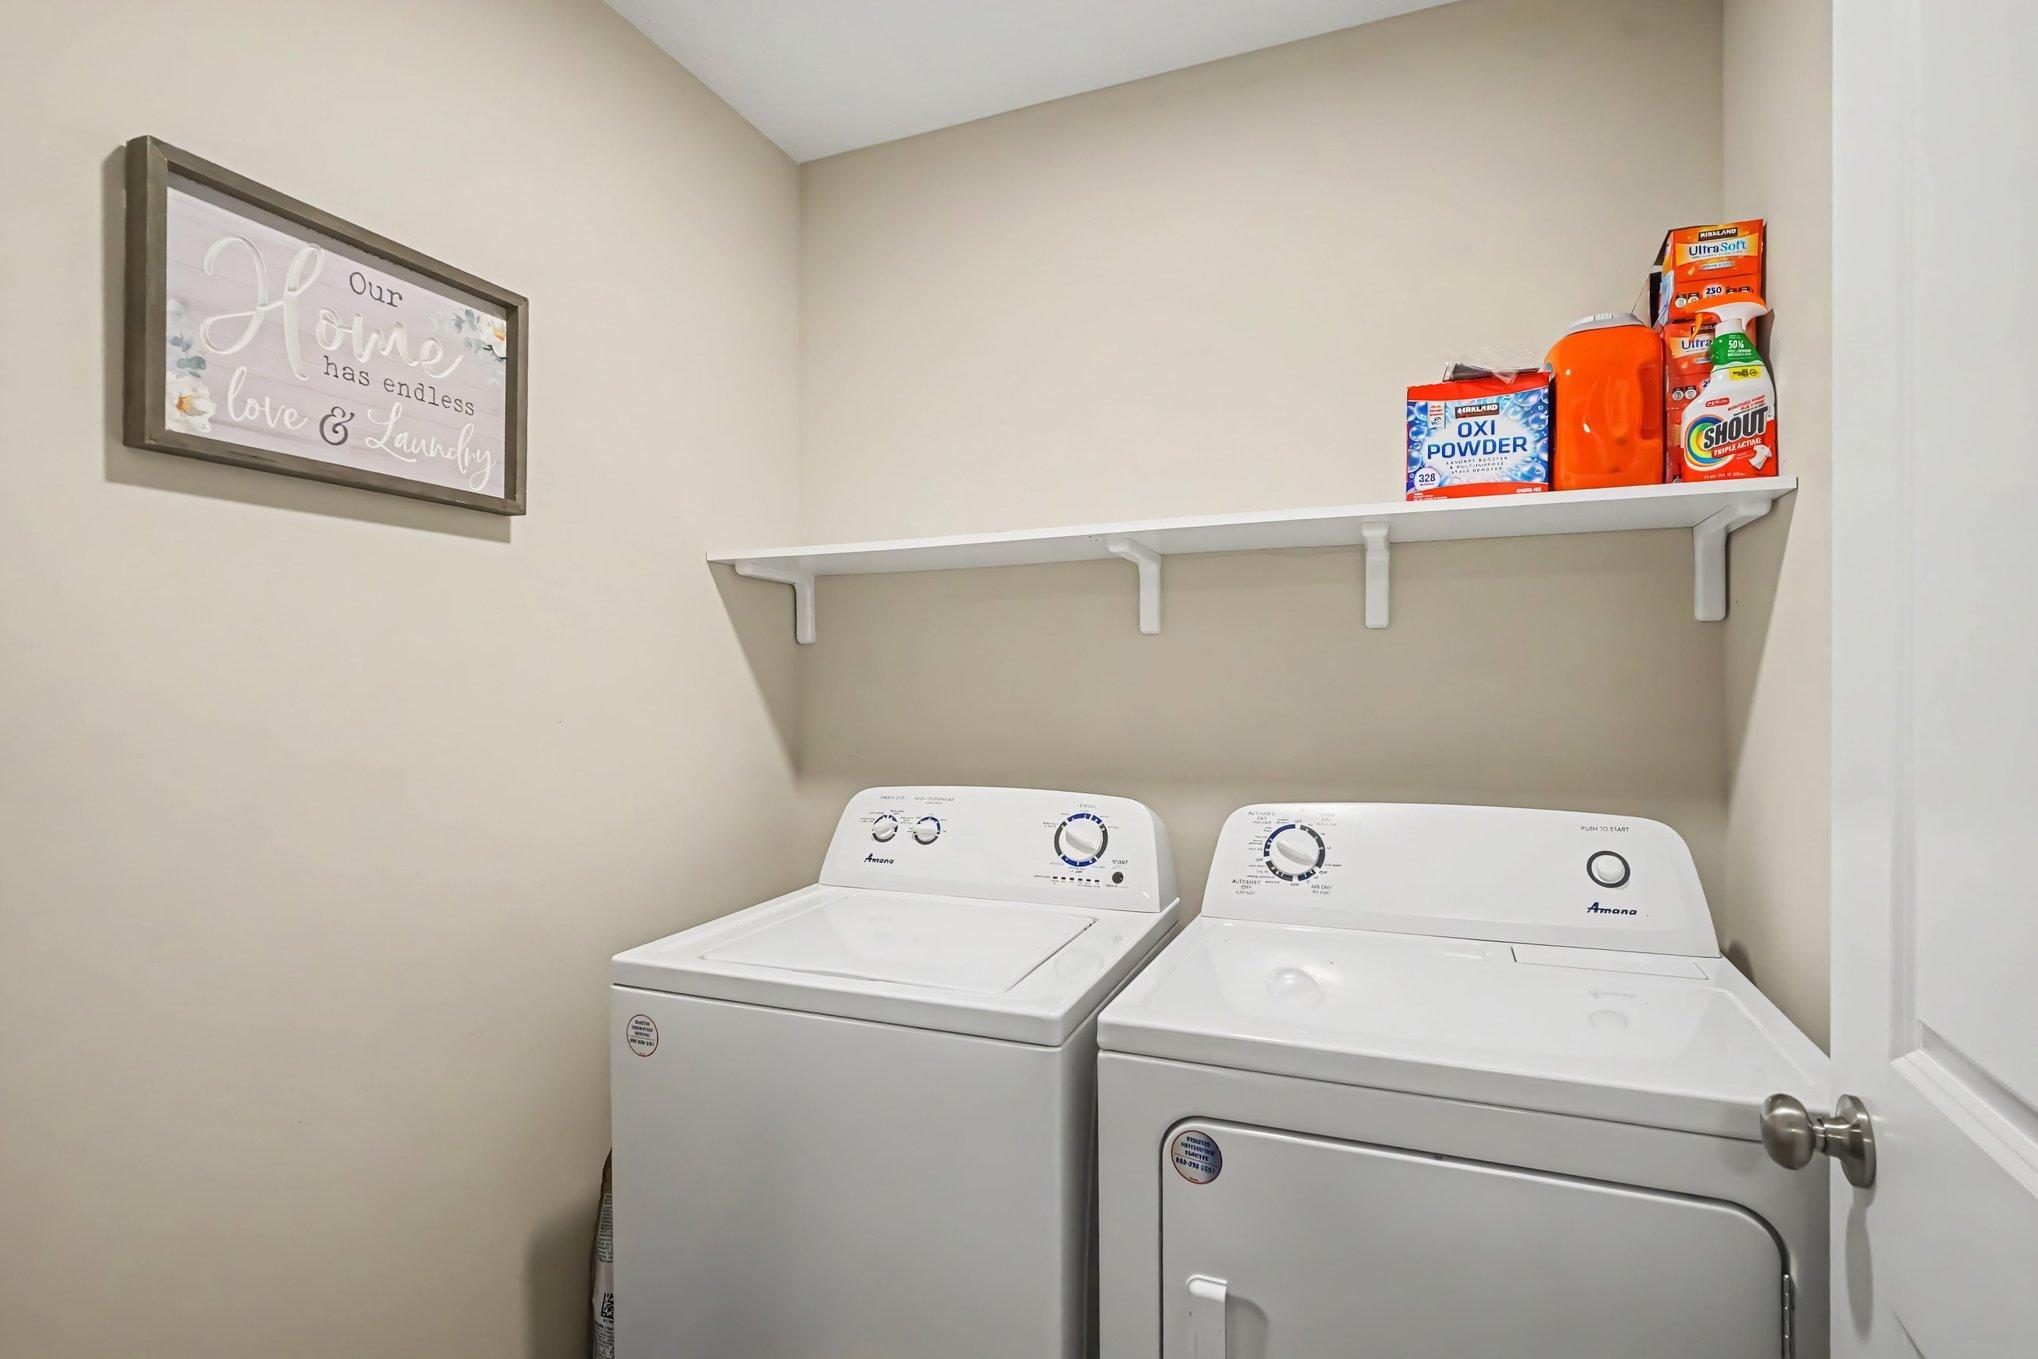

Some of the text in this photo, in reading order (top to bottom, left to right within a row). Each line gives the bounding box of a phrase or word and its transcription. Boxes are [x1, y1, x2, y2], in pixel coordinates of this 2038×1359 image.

[1699, 228, 1737, 239] KIRKLAND
[349, 271, 403, 308] Our
[1705, 286, 1722, 295] 250
[201, 236, 463, 381] Home
[323, 355, 475, 417] has endless
[227, 366, 496, 491] love & Laundry
[1457, 420, 1496, 438] OXI
[1703, 406, 1768, 450] SHOUT
[1427, 436, 1528, 460] POWDER
[1713, 444, 1736, 456] TRIPLE
[1418, 473, 1436, 484] 328
[864, 853, 894, 864] Amana
[1586, 901, 1637, 916] Amana
